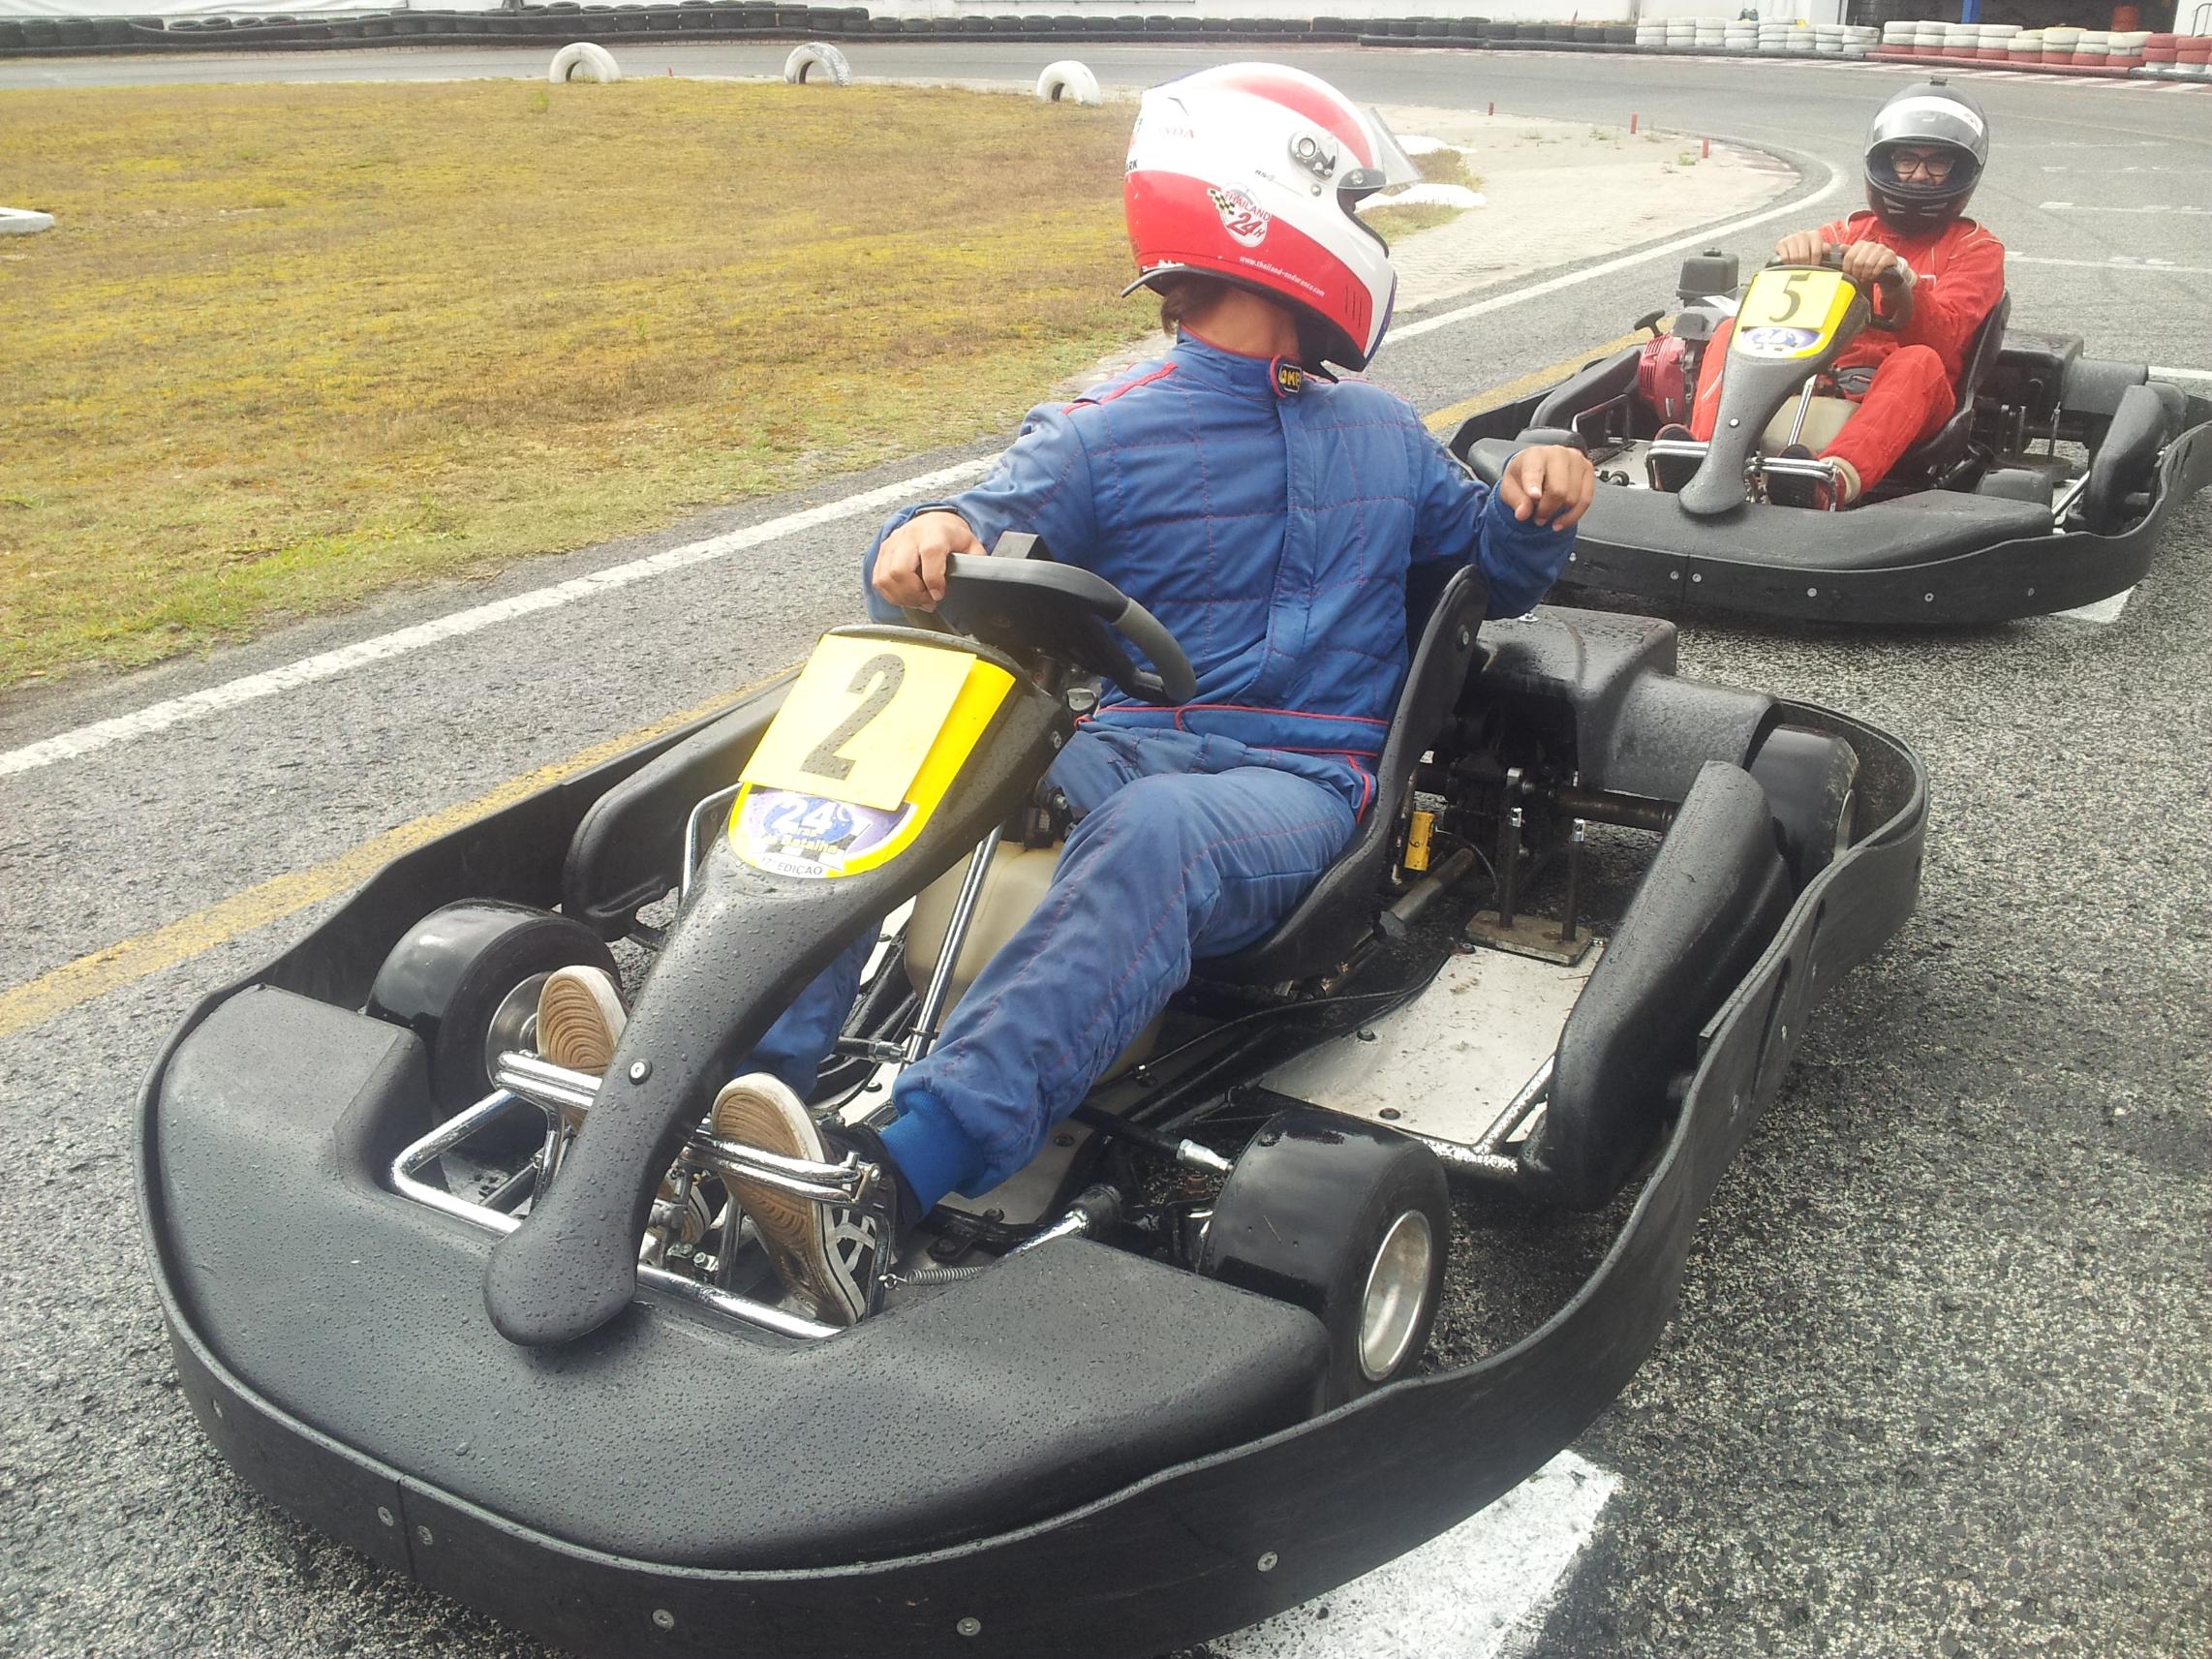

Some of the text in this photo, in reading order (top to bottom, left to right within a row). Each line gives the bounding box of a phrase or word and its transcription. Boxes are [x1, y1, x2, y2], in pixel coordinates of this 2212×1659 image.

[1223, 190, 1271, 222] THAILAND
[1768, 271, 1812, 323] 5
[799, 653, 906, 782] 2
[771, 796, 834, 835] 24
[781, 834, 838, 855] Batalha
